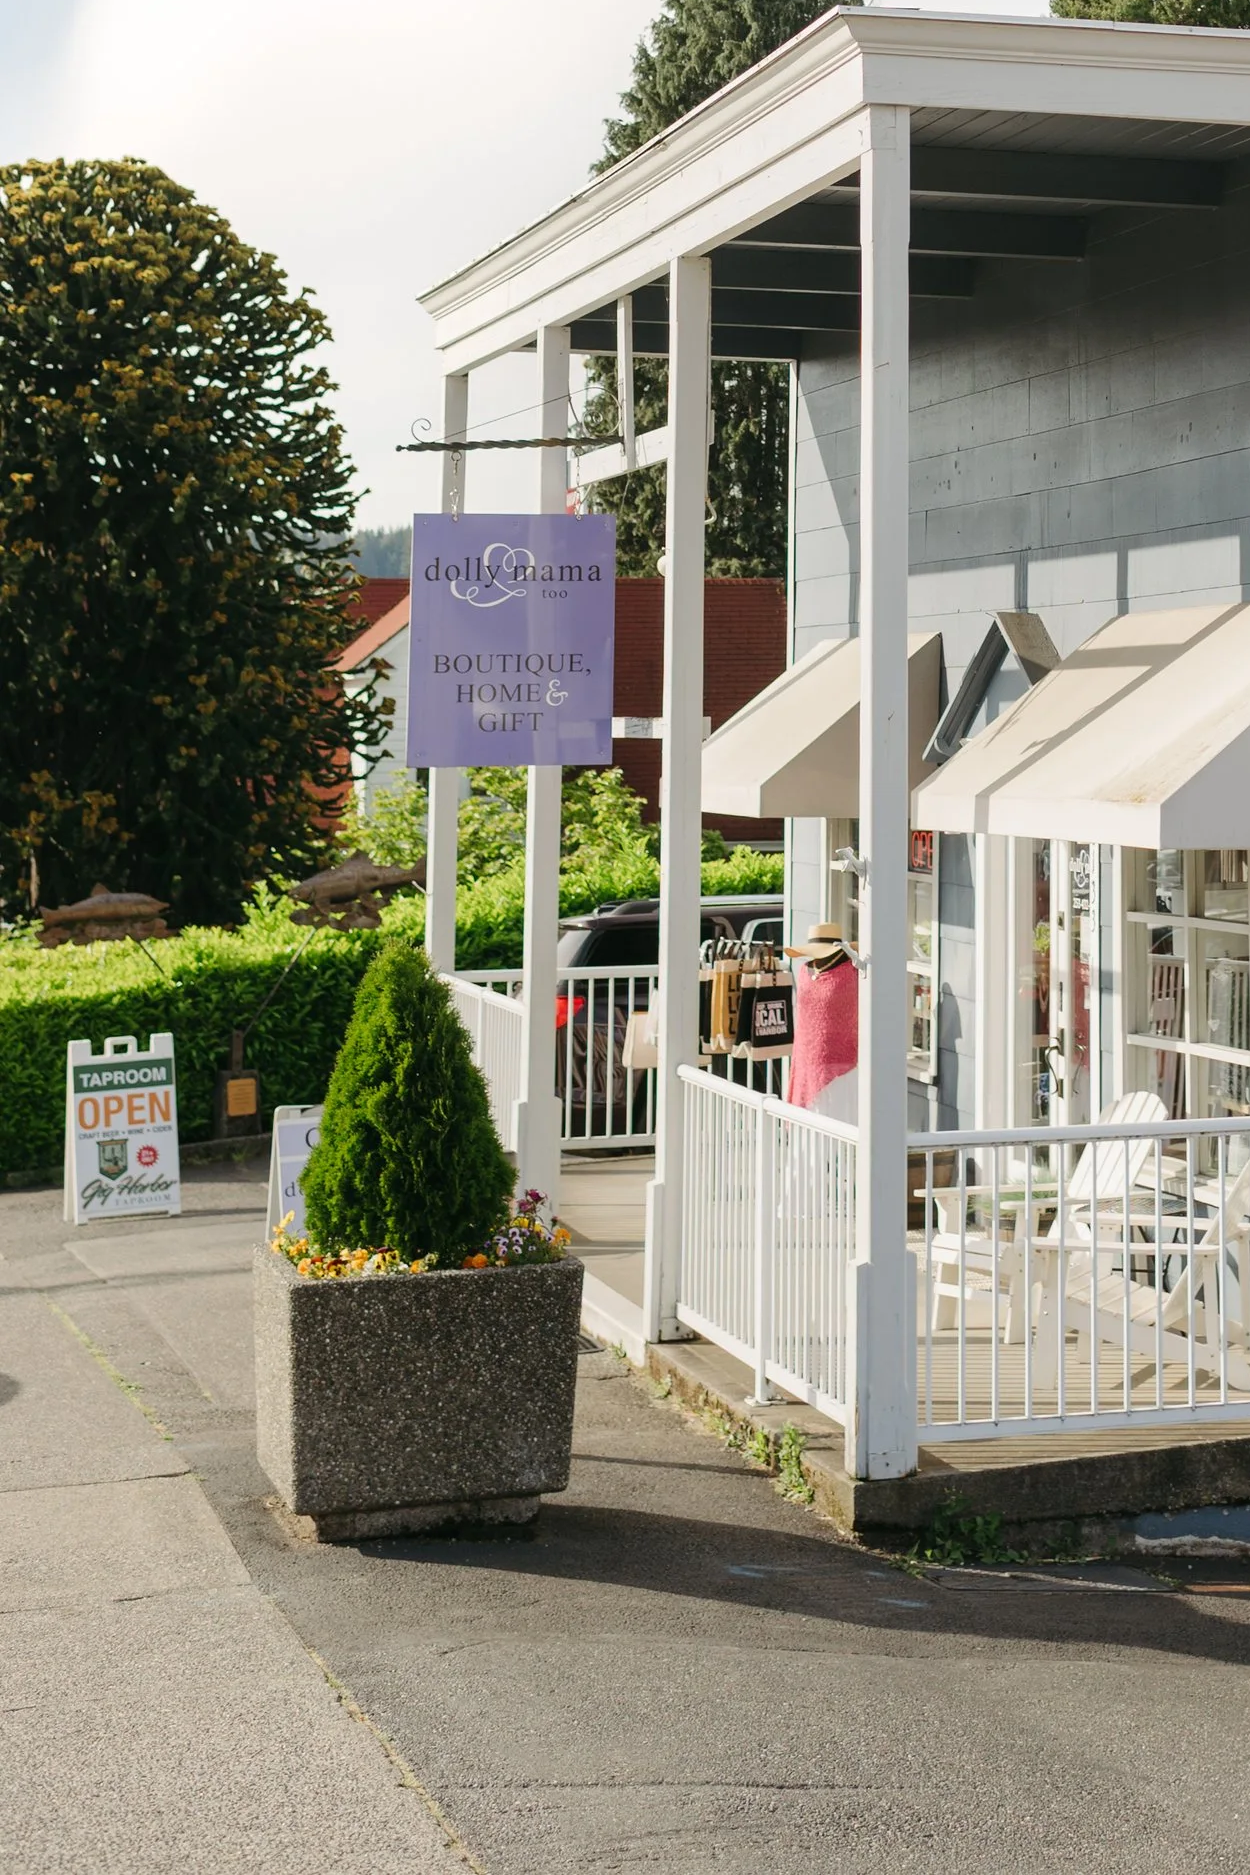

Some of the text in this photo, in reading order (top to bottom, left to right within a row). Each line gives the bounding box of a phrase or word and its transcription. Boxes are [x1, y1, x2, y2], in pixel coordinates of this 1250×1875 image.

[424, 557, 602, 589] dolly mama
[542, 588, 569, 599] too
[433, 653, 592, 676] BOUTIQUE,
[456, 678, 569, 707] HOME &
[478, 711, 544, 733] GIFT
[79, 1066, 167, 1089] TAPROOM
[78, 1090, 171, 1131] OPEN
[79, 1132, 100, 1140] CRAFT
[152, 1125, 173, 1133] CIDER
[81, 1172, 178, 1210] Gig Harbor
[115, 1194, 171, 1206] TAPROOM
